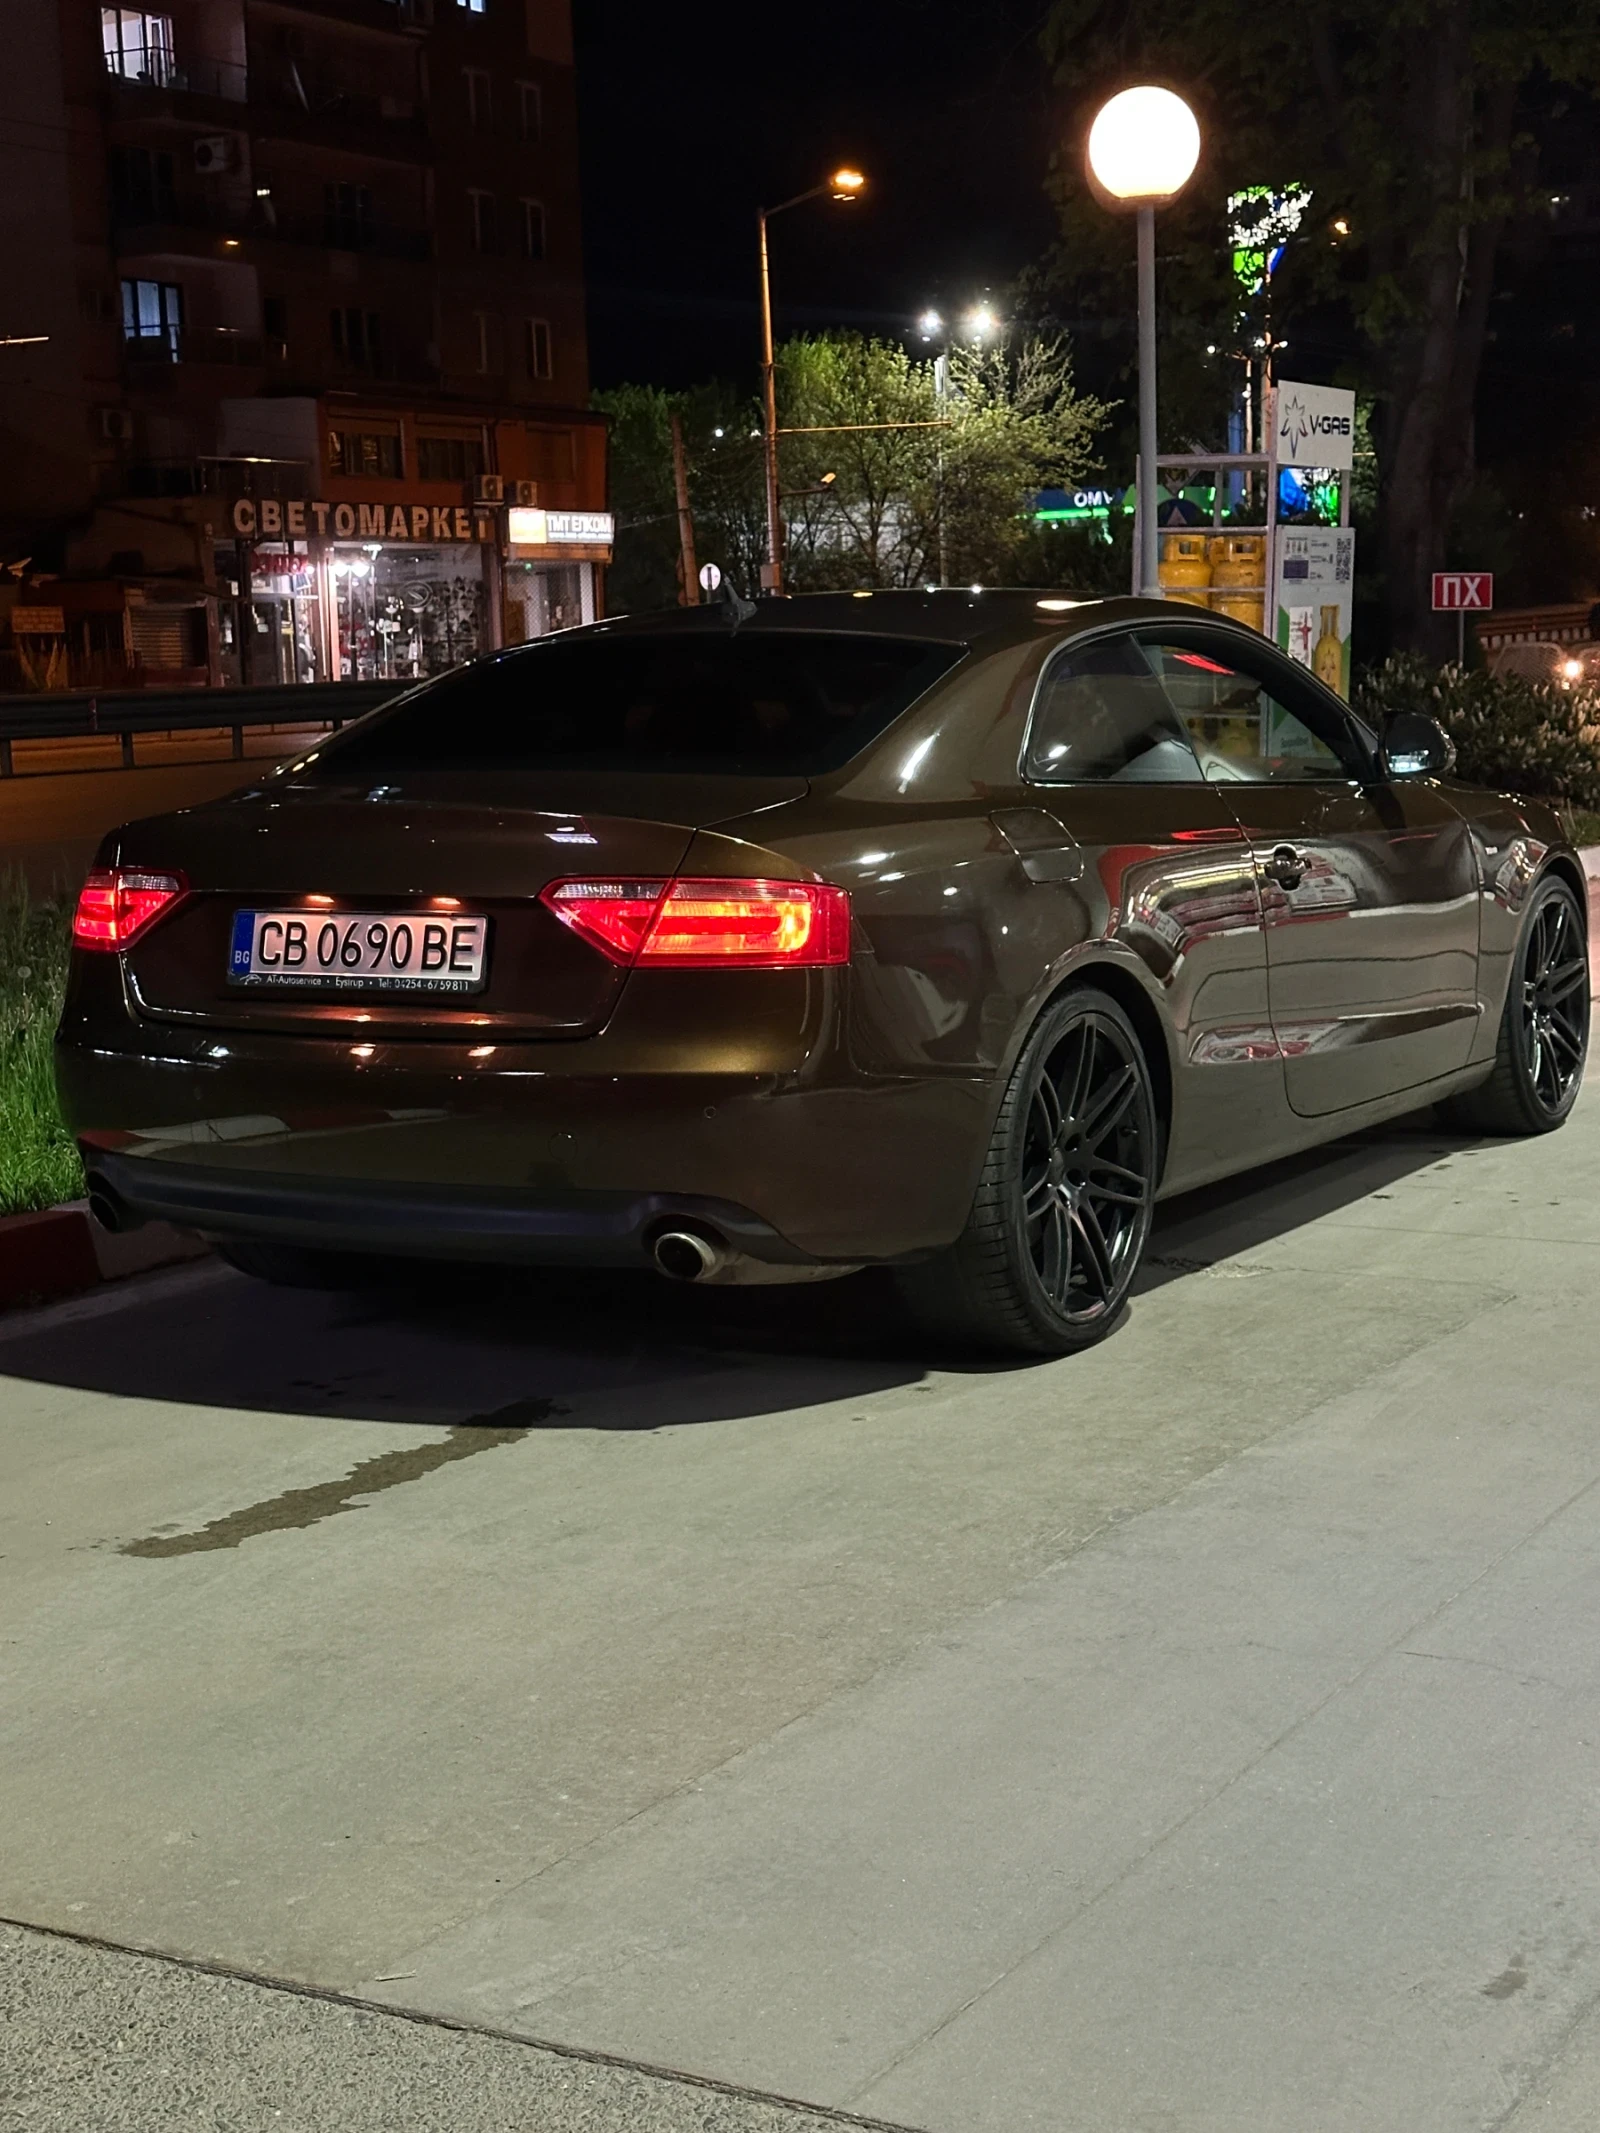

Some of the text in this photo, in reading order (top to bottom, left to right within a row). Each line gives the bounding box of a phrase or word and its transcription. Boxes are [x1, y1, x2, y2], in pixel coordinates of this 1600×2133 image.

[233, 499, 490, 539] СВЕТОМАРКЕТ
[1442, 576, 1482, 607] ПХ
[234, 949, 250, 964] BG
[258, 920, 478, 973] CB 0690 BE
